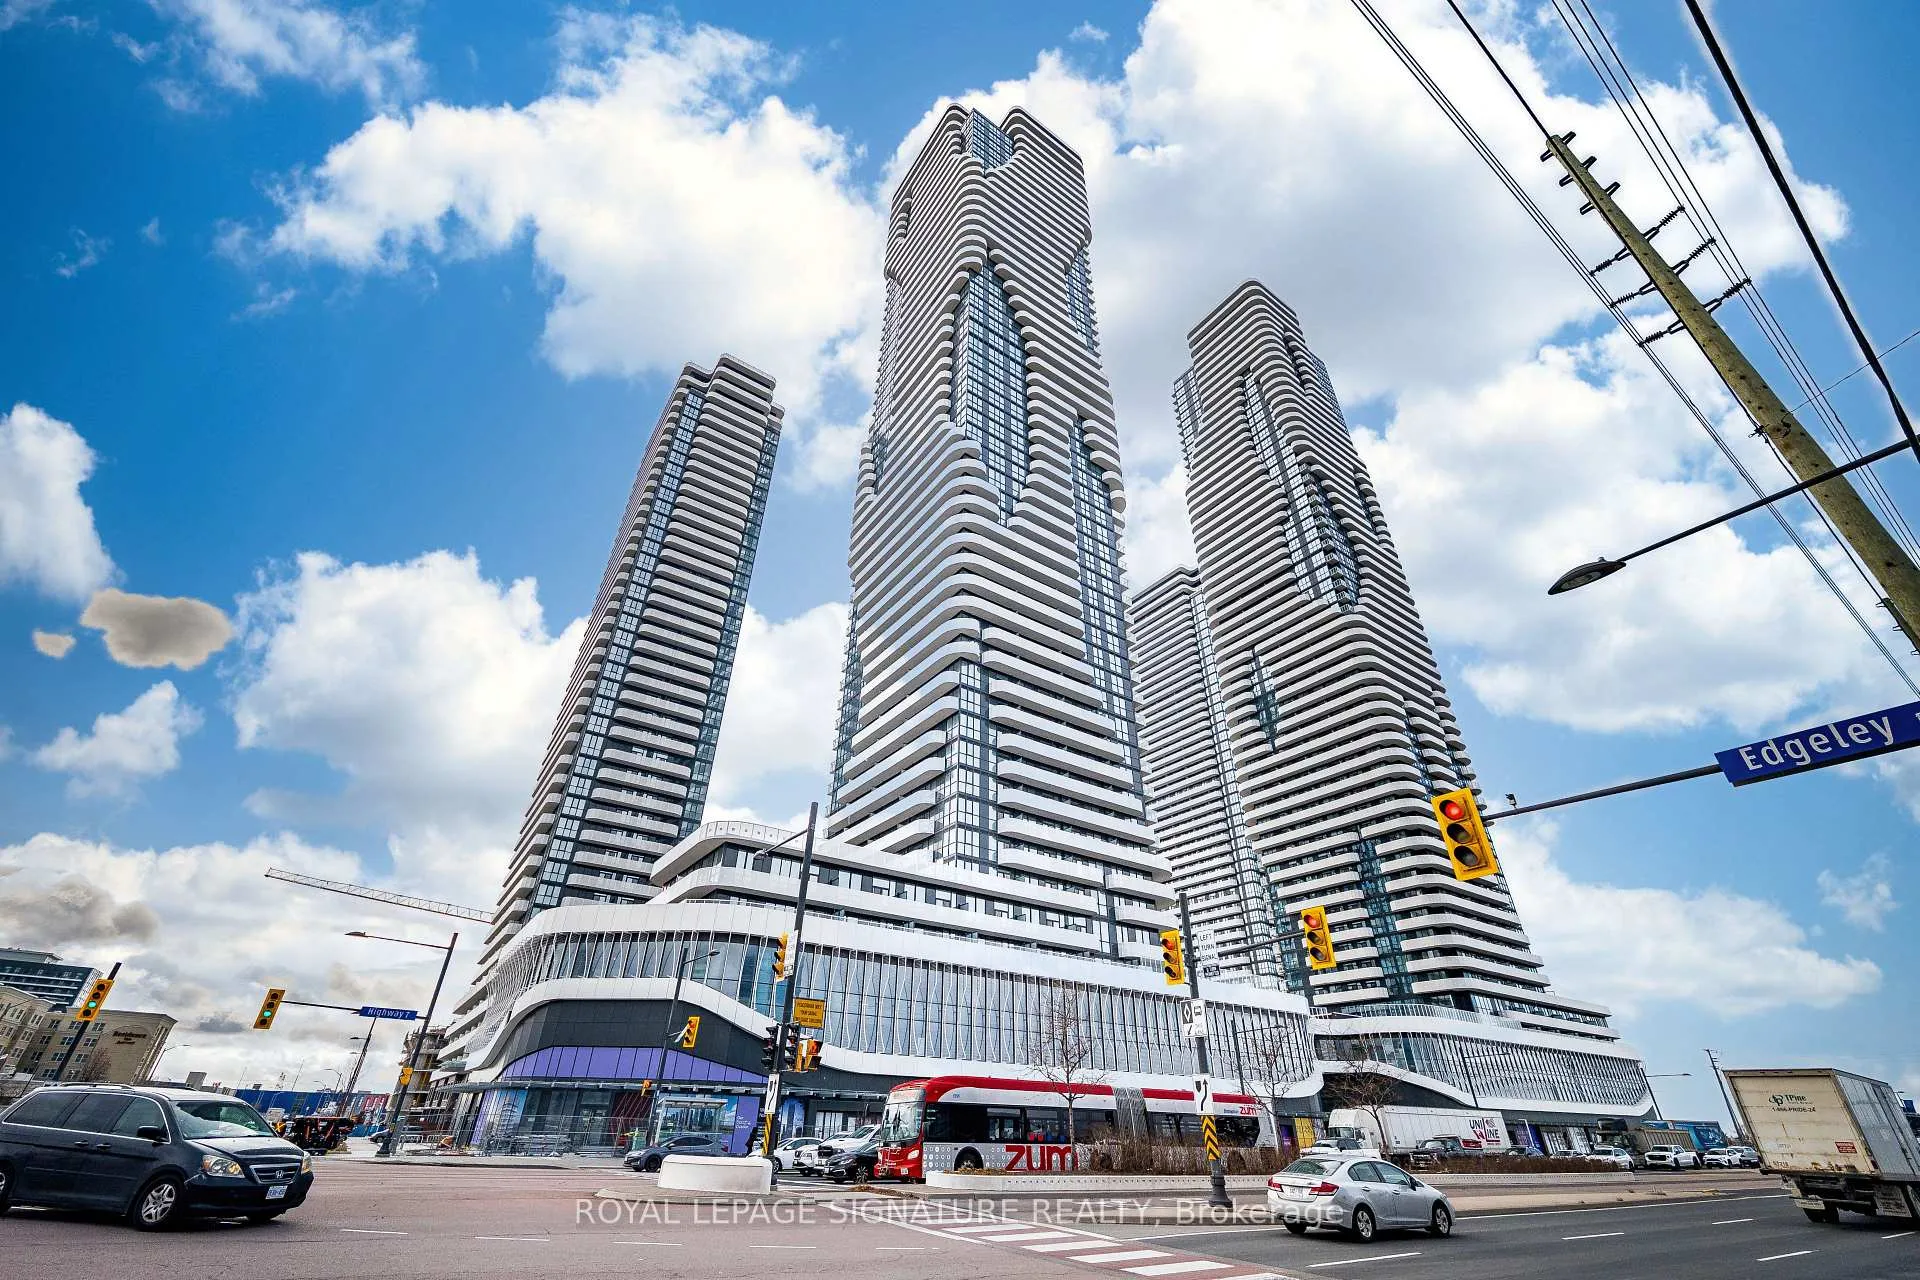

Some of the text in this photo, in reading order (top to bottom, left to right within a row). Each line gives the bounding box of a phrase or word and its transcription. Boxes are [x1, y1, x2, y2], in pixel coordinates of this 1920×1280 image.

[1738, 716, 1894, 771] Edgeley
[1199, 933, 1212, 941] LEFT
[1201, 944, 1215, 952] TURN
[367, 1007, 404, 1018] Highway
